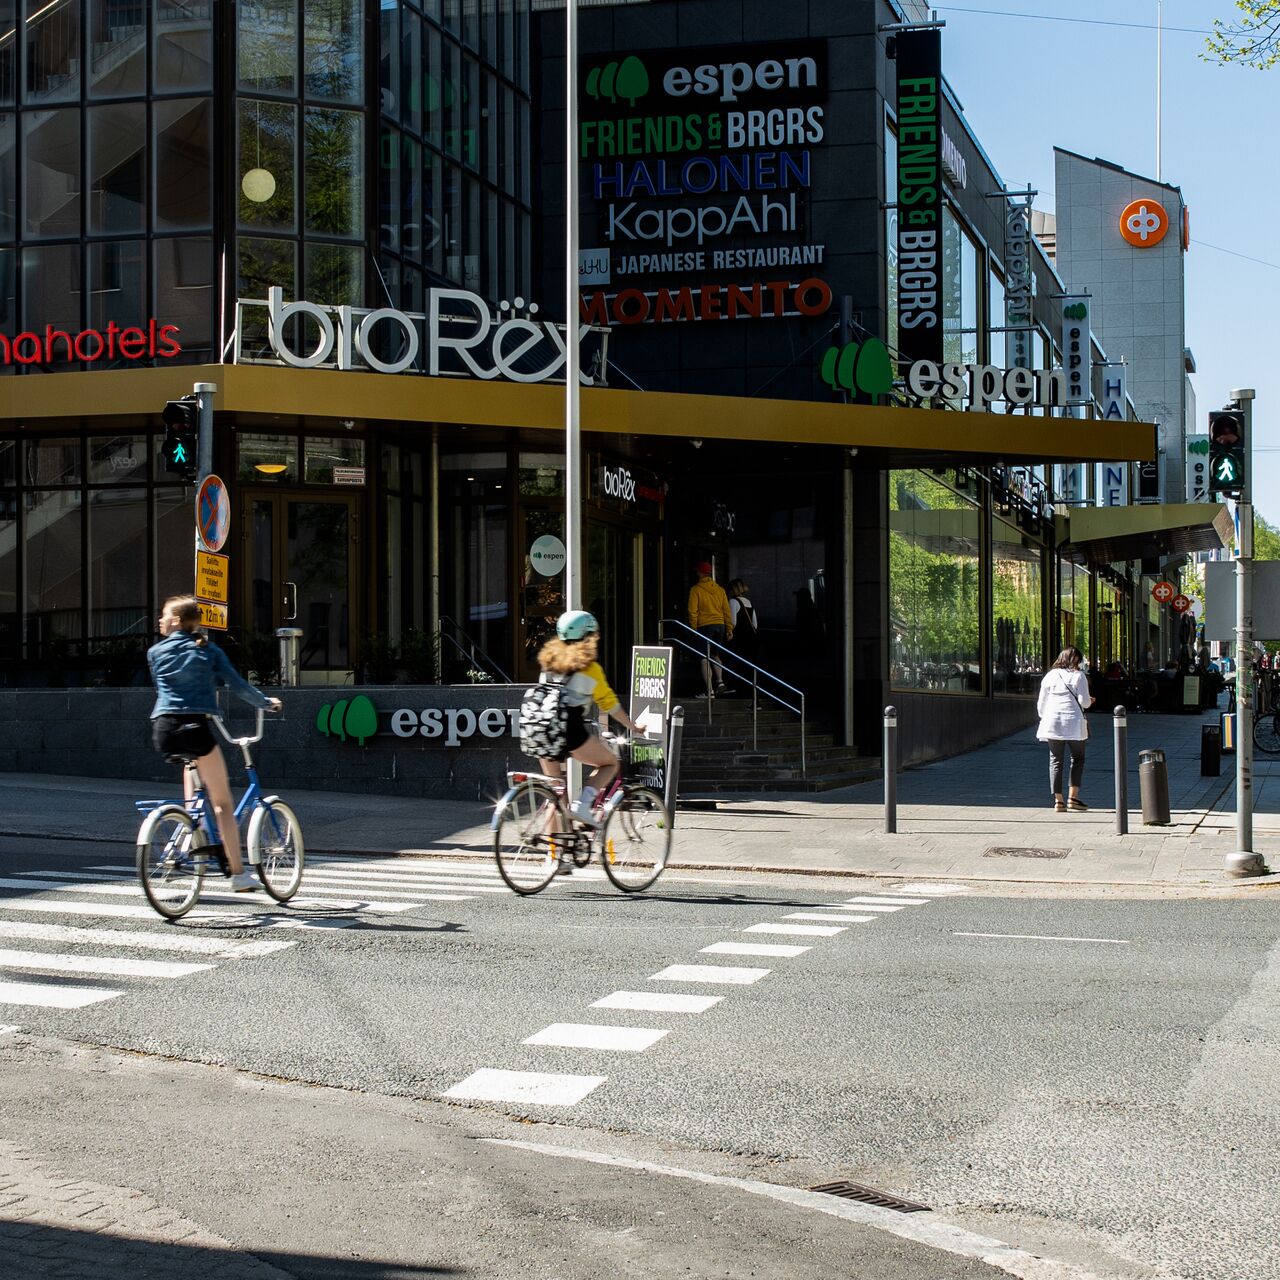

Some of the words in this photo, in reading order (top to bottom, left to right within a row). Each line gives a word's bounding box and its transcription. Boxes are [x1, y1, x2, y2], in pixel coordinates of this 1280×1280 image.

[662, 56, 818, 103] espen
[581, 113, 702, 158] FRIENDS
[708, 113, 722, 149] &
[728, 106, 824, 148] BRGRS
[899, 77, 937, 205] FRIENDS
[593, 150, 811, 199] HALONEN
[609, 192, 796, 247] KappAhl
[617, 251, 705, 274] JAPANESE
[713, 245, 825, 270] RESTAURANT
[899, 230, 937, 330] BRGRS
[579, 277, 833, 326] MOMENTO
[908, 358, 1069, 413] espen
[1069, 326, 1082, 397] espen
[543, 552, 564, 561] espen
[635, 656, 666, 677] FRIENDS
[639, 677, 665, 699] BRGRS
